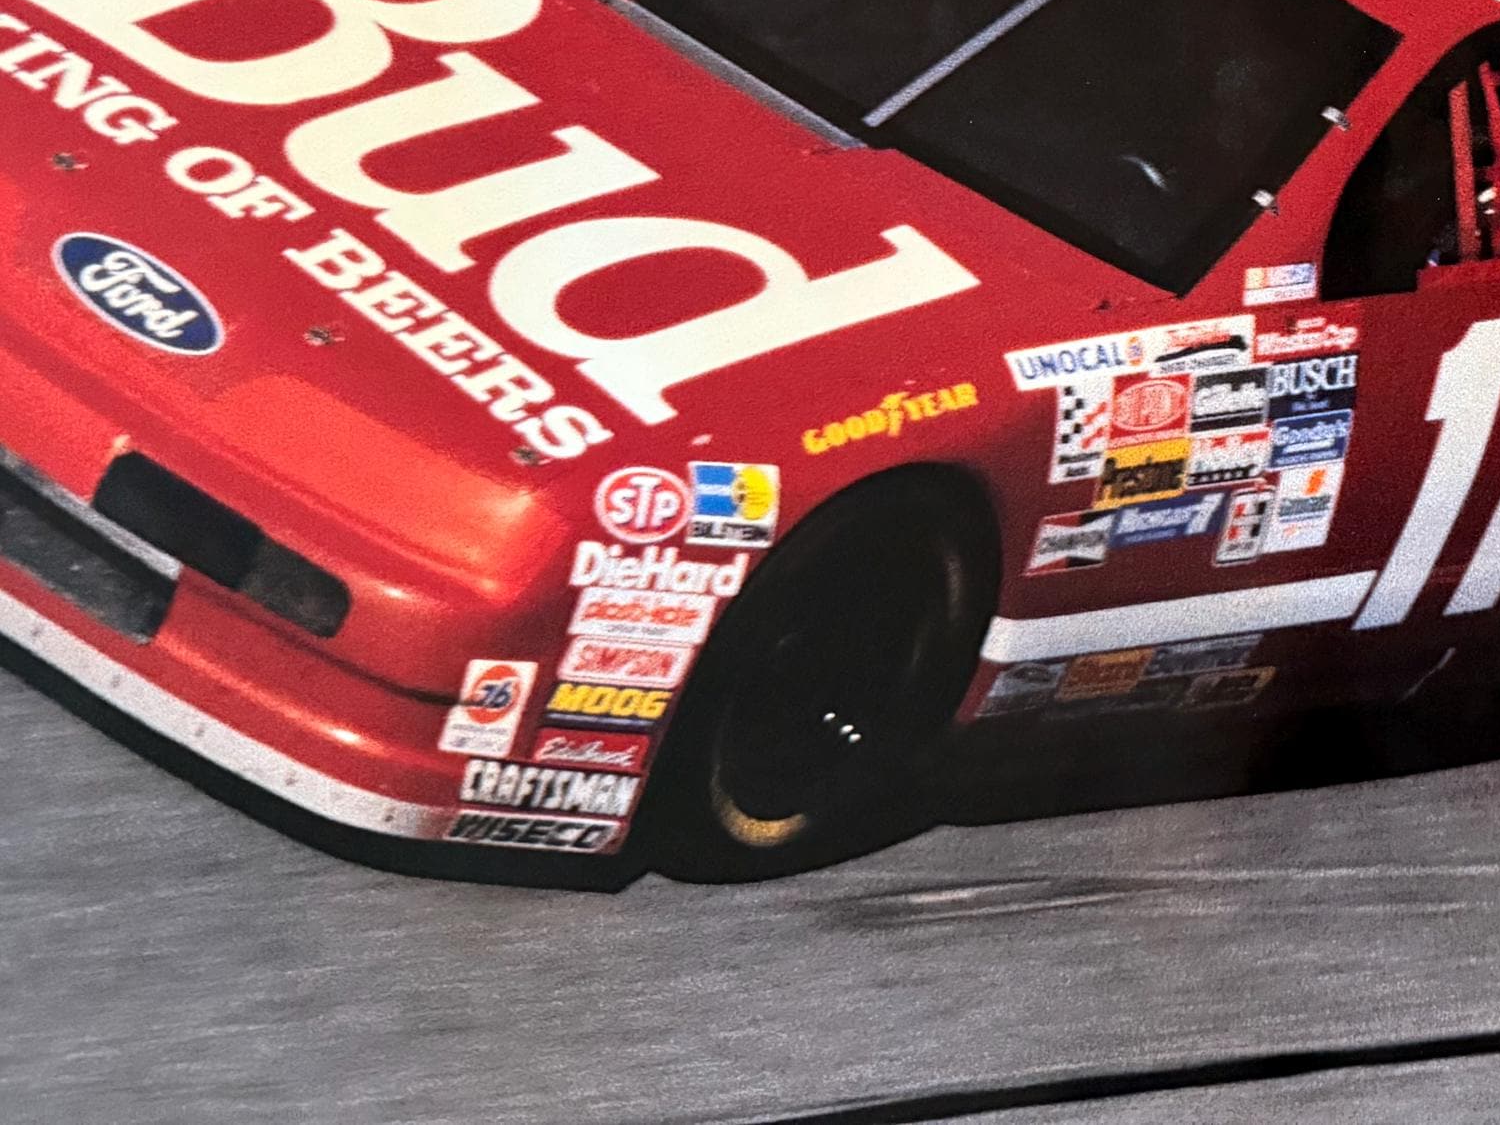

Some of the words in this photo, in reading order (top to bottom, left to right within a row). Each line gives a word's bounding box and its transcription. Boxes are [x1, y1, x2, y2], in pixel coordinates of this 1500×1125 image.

[80, 249, 199, 341] Ford
[165, 146, 316, 219] OF
[282, 227, 614, 461] BEERS
[1016, 341, 1125, 380] UNOCAL
[1268, 355, 1358, 397] BUSCH
[608, 475, 680, 530] STP
[568, 539, 749, 598] DieHard
[476, 680, 513, 709] 76
[546, 682, 673, 720] MOOG
[459, 759, 641, 817] CRAFTSMAN
[448, 813, 606, 849] WISECO
